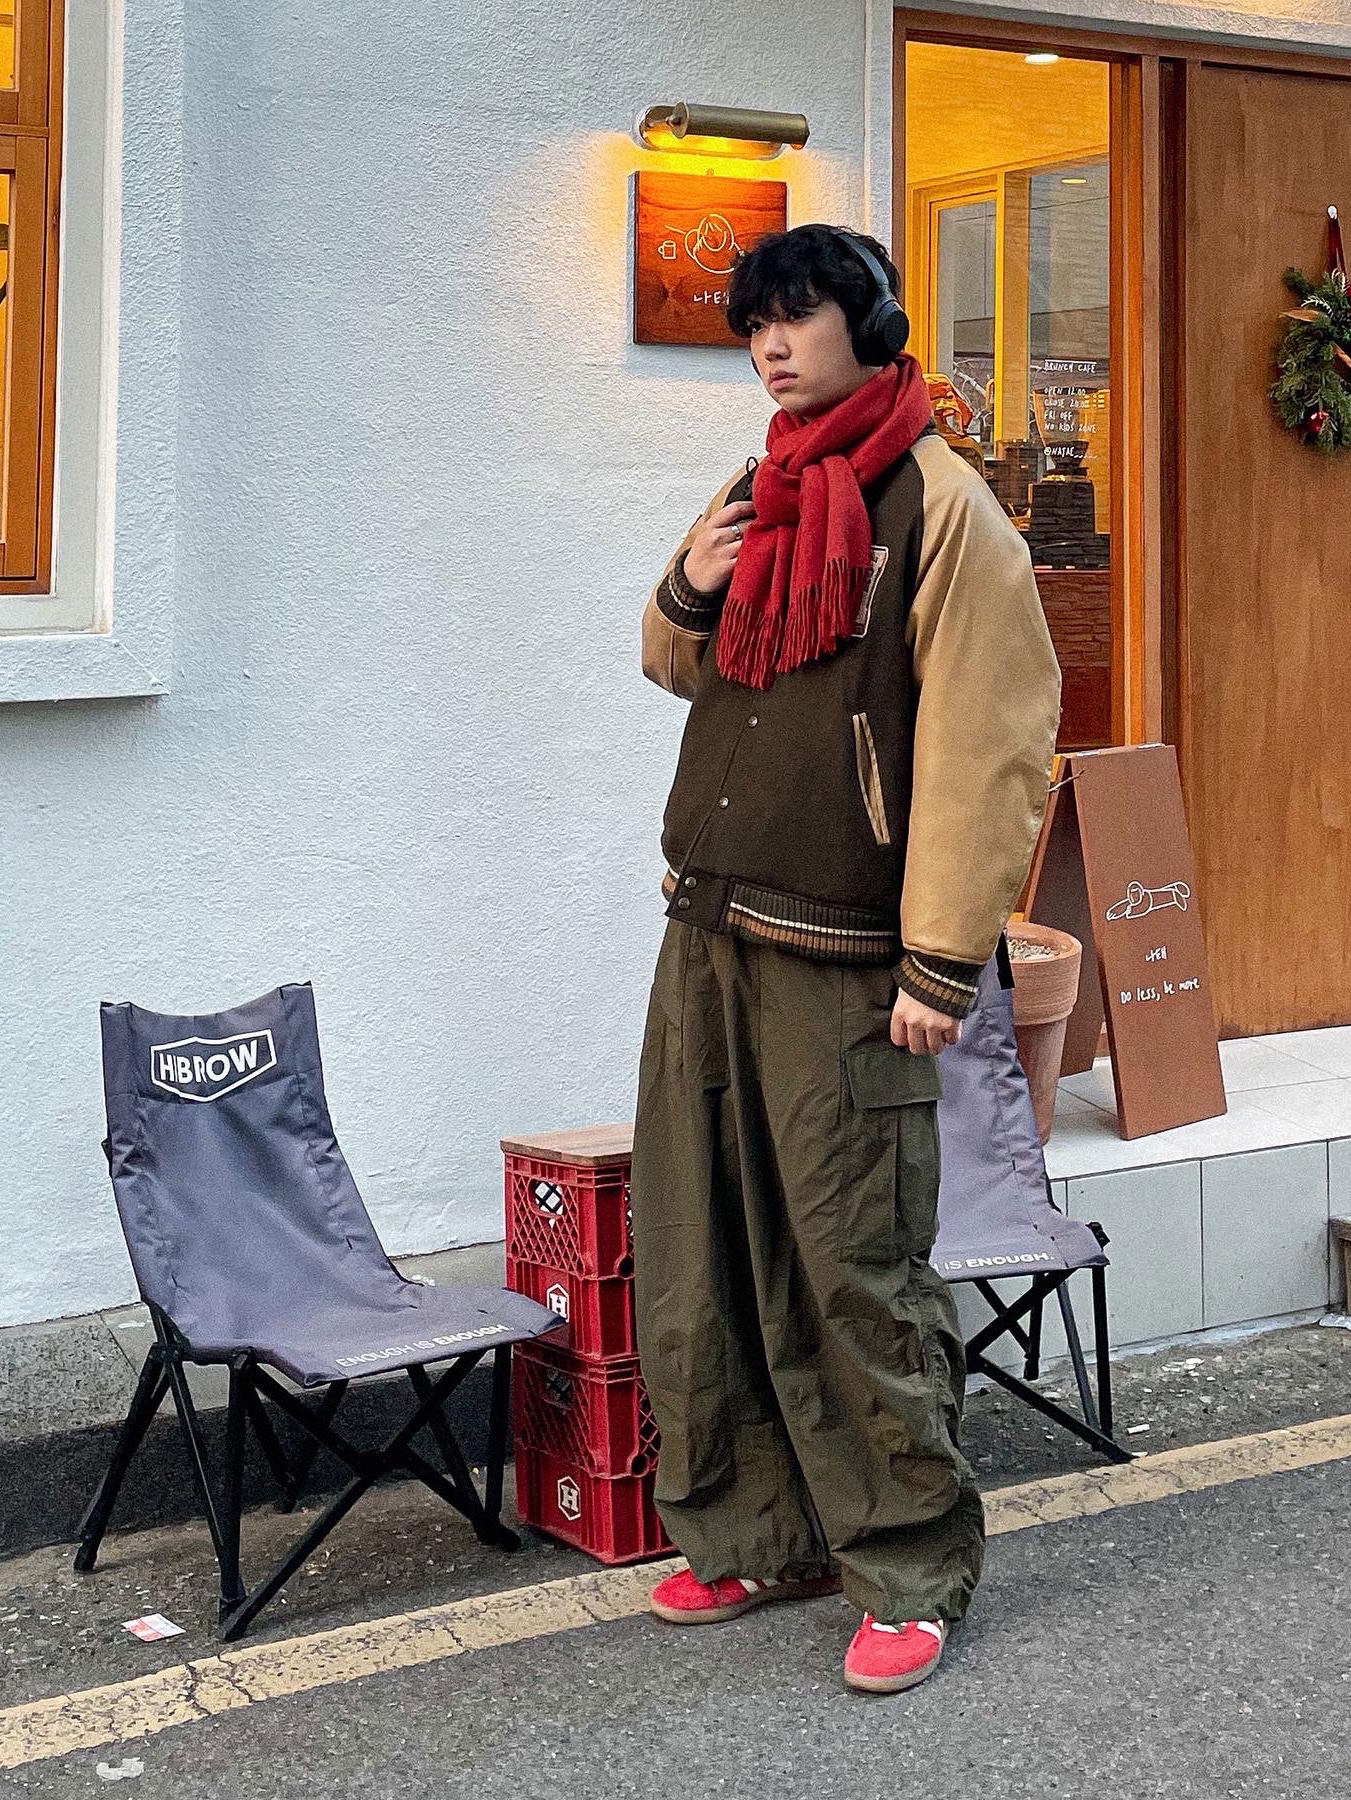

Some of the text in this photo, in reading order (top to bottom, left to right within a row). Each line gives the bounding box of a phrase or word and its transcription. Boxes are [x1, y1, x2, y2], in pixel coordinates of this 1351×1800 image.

[1077, 364, 1096, 373] CAFE
[1044, 386, 1063, 396] OPEN
[1044, 410, 1073, 420] FRI OFF
[1044, 422, 1055, 431] NO
[1059, 422, 1074, 432] KIDS
[1137, 987, 1161, 1001] less,
[1163, 981, 1175, 995] be
[1179, 977, 1201, 992] more
[944, 1260, 962, 1271] IS
[965, 1252, 1055, 1269] ENOUGH.
[335, 1344, 415, 1368] ENOUGH
[413, 1339, 436, 1354] IS
[560, 1484, 579, 1513] H
